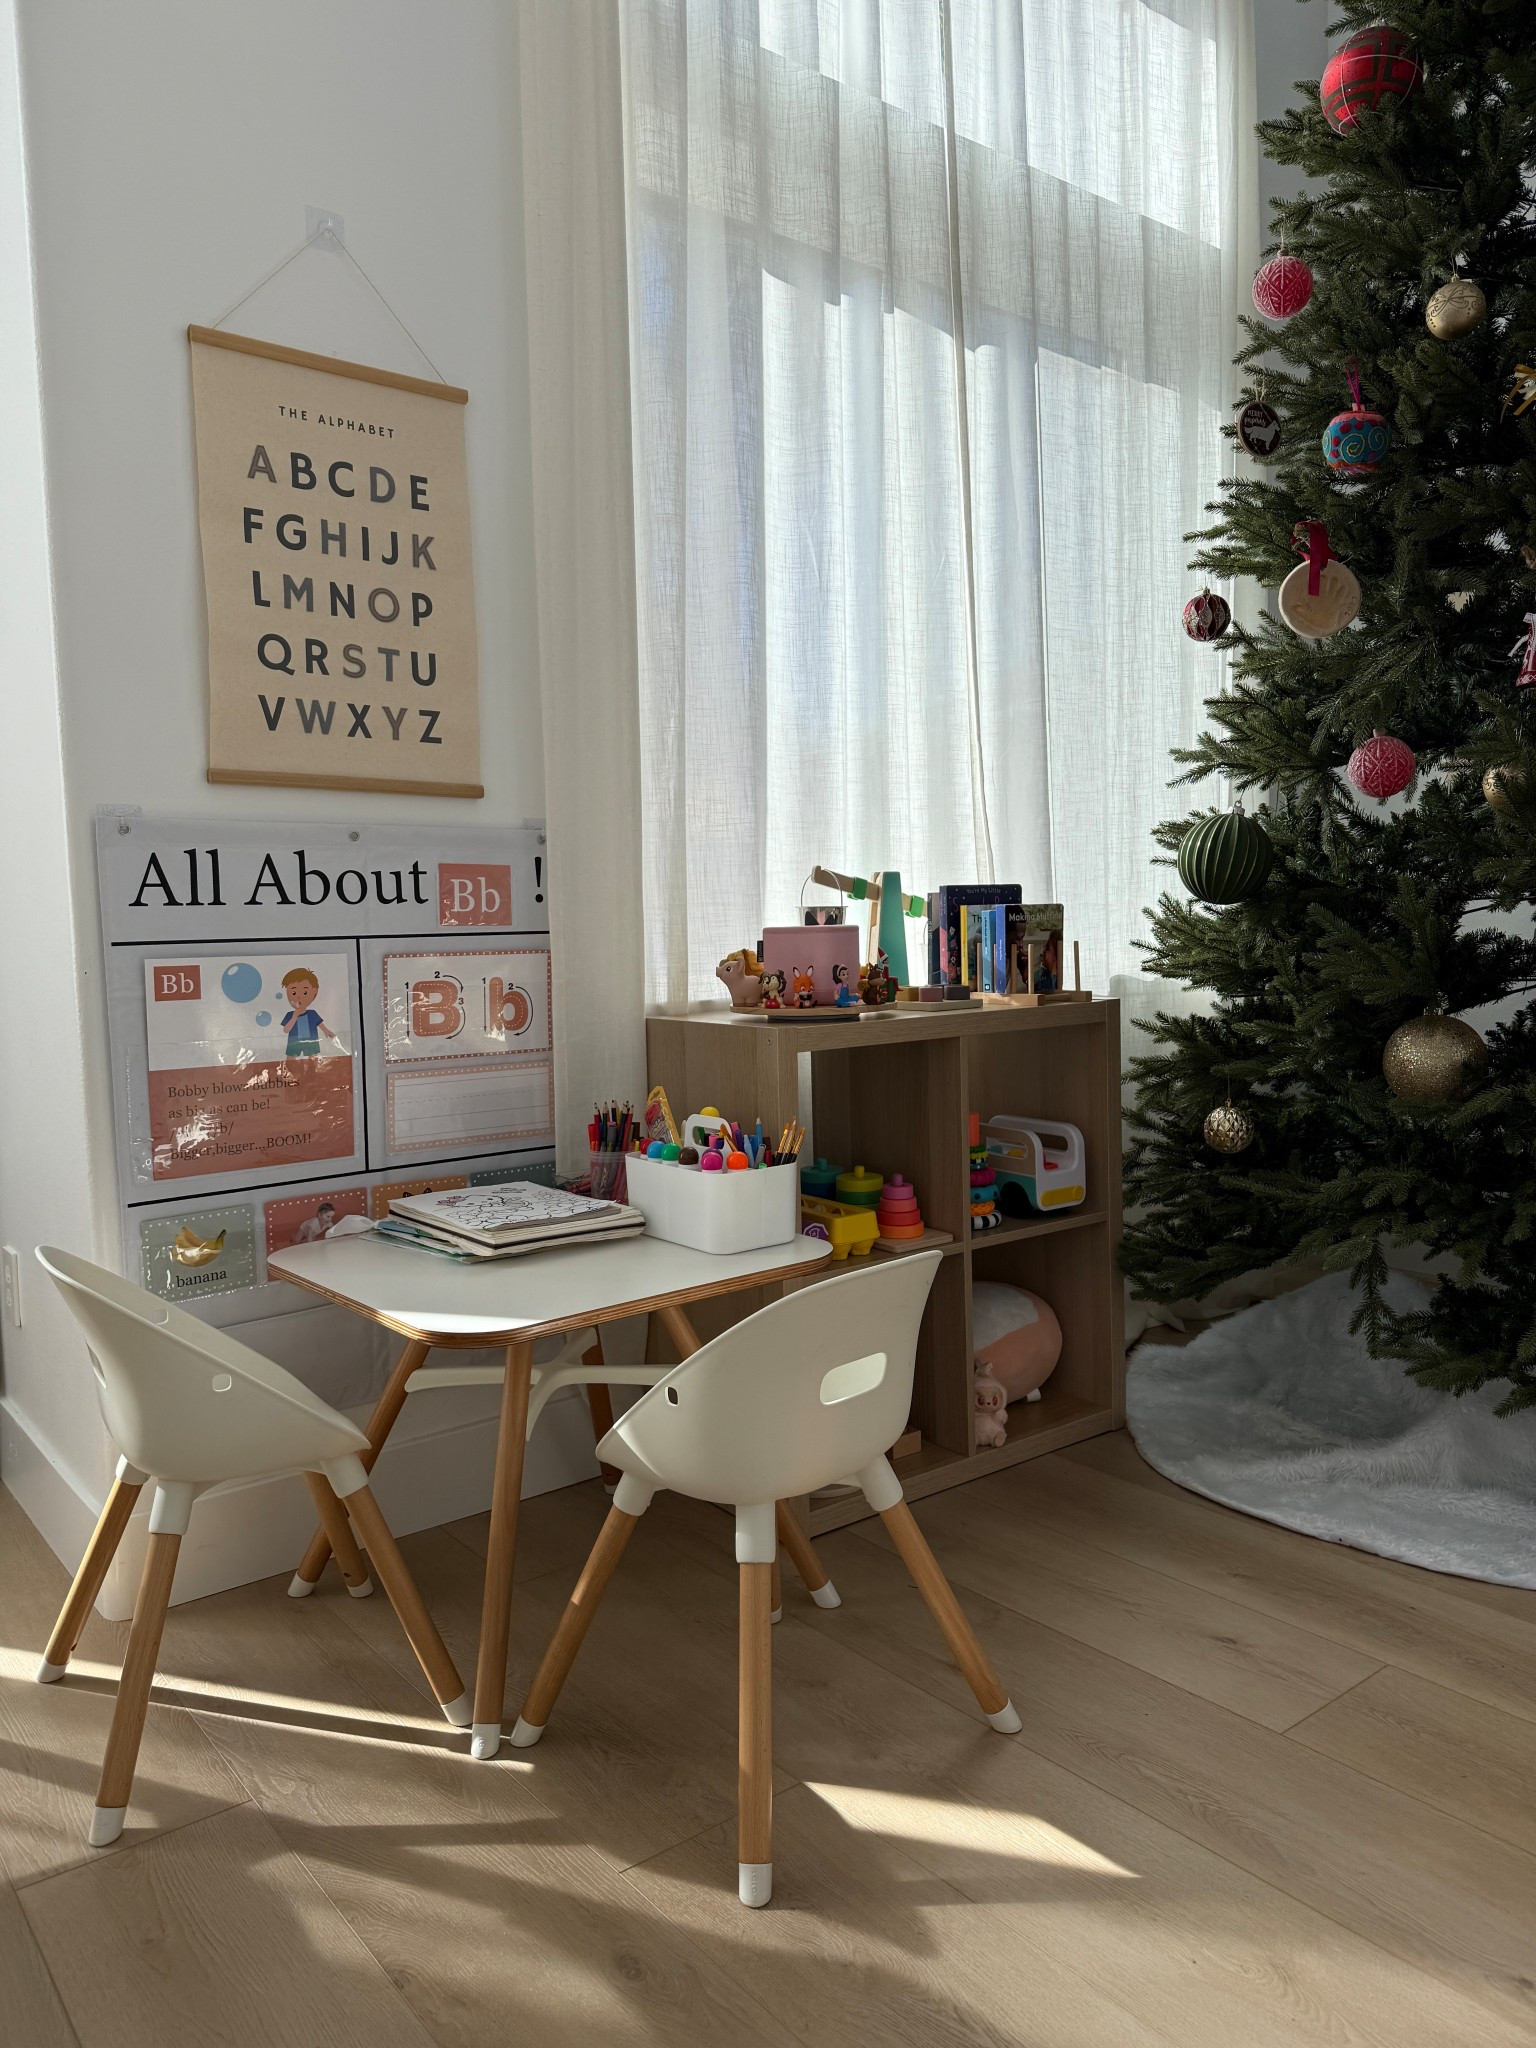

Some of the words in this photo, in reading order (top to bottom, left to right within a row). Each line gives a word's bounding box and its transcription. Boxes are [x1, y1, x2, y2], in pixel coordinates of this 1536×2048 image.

[278, 405, 308, 421] THE
[318, 414, 395, 439] ALPHABET
[128, 848, 226, 908] All
[243, 849, 429, 907] About
[449, 876, 501, 914] Bb
[971, 914, 983, 924] Th
[1008, 912, 1035, 923] Making
[160, 973, 195, 995] Bb
[434, 970, 441, 979] 2
[507, 982, 514, 991] 2
[412, 979, 461, 1037] B
[488, 976, 529, 1032] b
[167, 1084, 209, 1098] Bobby
[212, 1082, 249, 1095] blows
[168, 1108, 183, 1119] as
[209, 1105, 223, 1114] as
[226, 1103, 248, 1113] can
[252, 1098, 271, 1111] be!
[176, 1269, 228, 1288] banana
